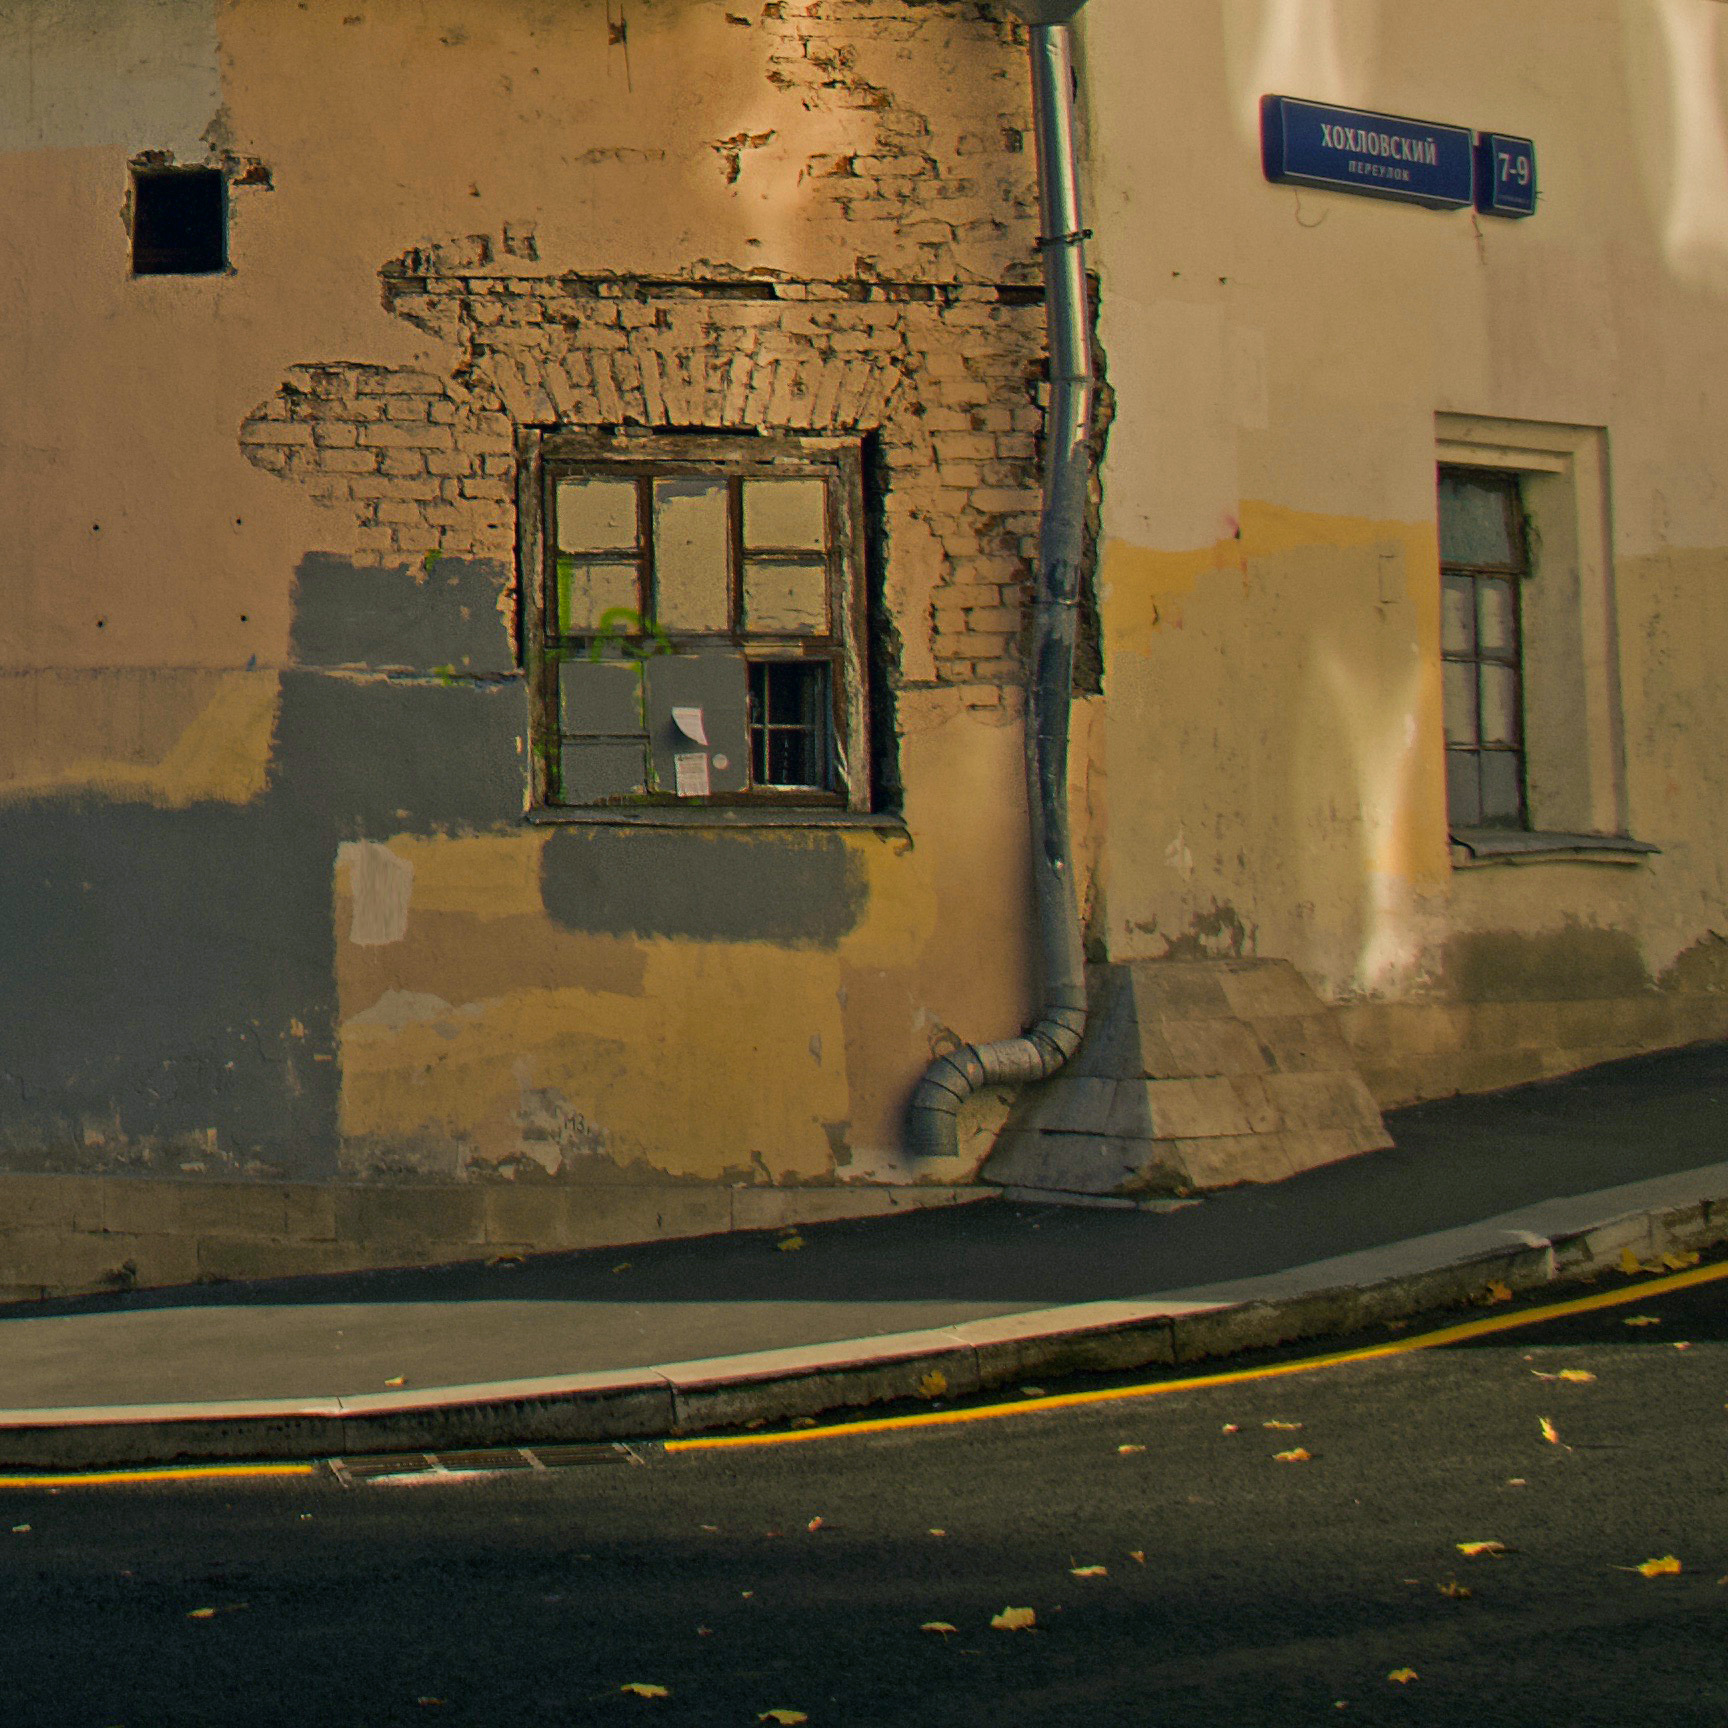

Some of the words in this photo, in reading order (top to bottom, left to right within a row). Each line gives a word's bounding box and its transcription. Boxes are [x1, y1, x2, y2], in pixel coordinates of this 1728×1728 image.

[1321, 123, 1438, 166] ХОХЛОВСКИЙ
[1348, 160, 1411, 182] ПЕРЕУЛОК
[1498, 152, 1530, 186] 7-9
